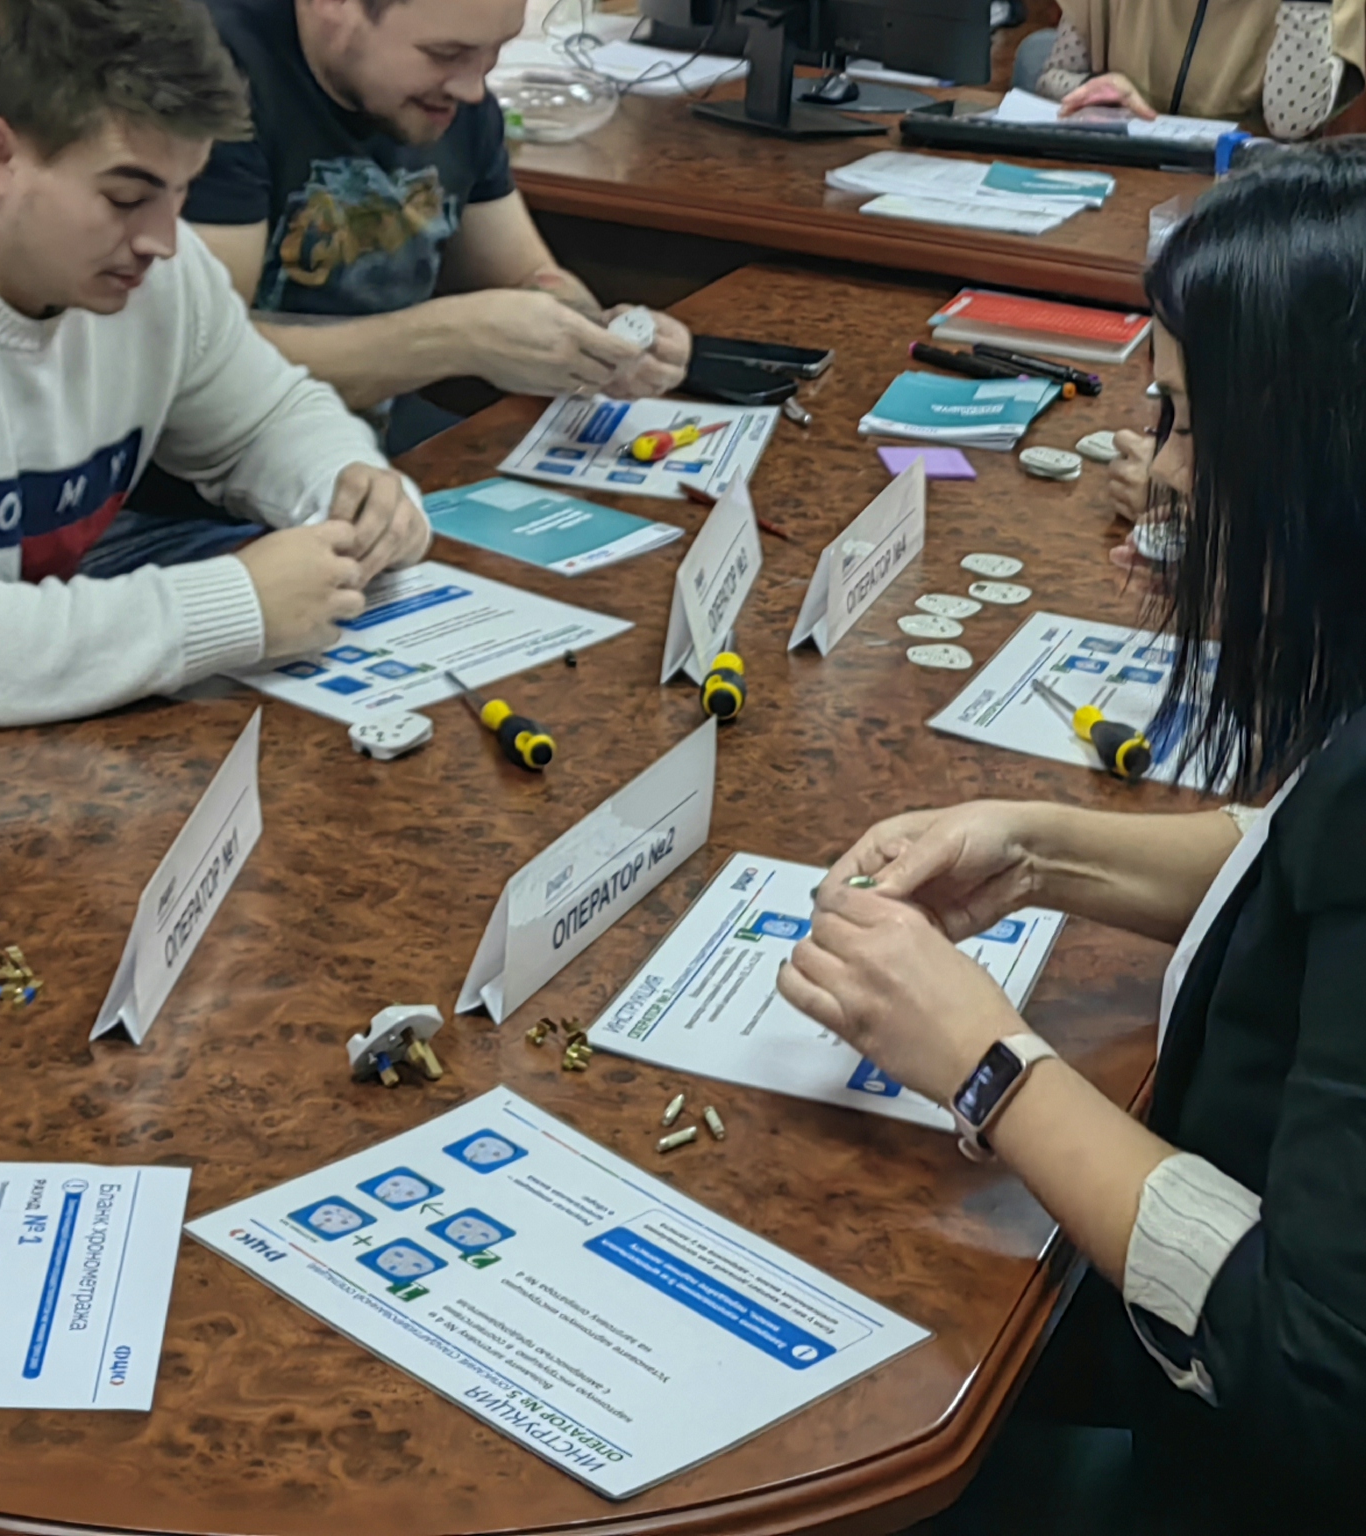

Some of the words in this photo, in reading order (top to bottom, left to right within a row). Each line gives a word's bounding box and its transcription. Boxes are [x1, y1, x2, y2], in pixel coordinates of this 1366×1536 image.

[164, 855, 220, 969] ОПЕРАТОР
[553, 851, 645, 951] ОПЕРАТОР
[647, 826, 676, 871] №2
[24, 1178, 47, 1210] РАУНД
[91, 1183, 121, 1225] Бланк
[63, 1228, 108, 1331] хронометража
[461, 1383, 609, 1473] ИНСТРУКЦИЯ
[537, 1409, 626, 1463] ОПЕРАТОР
